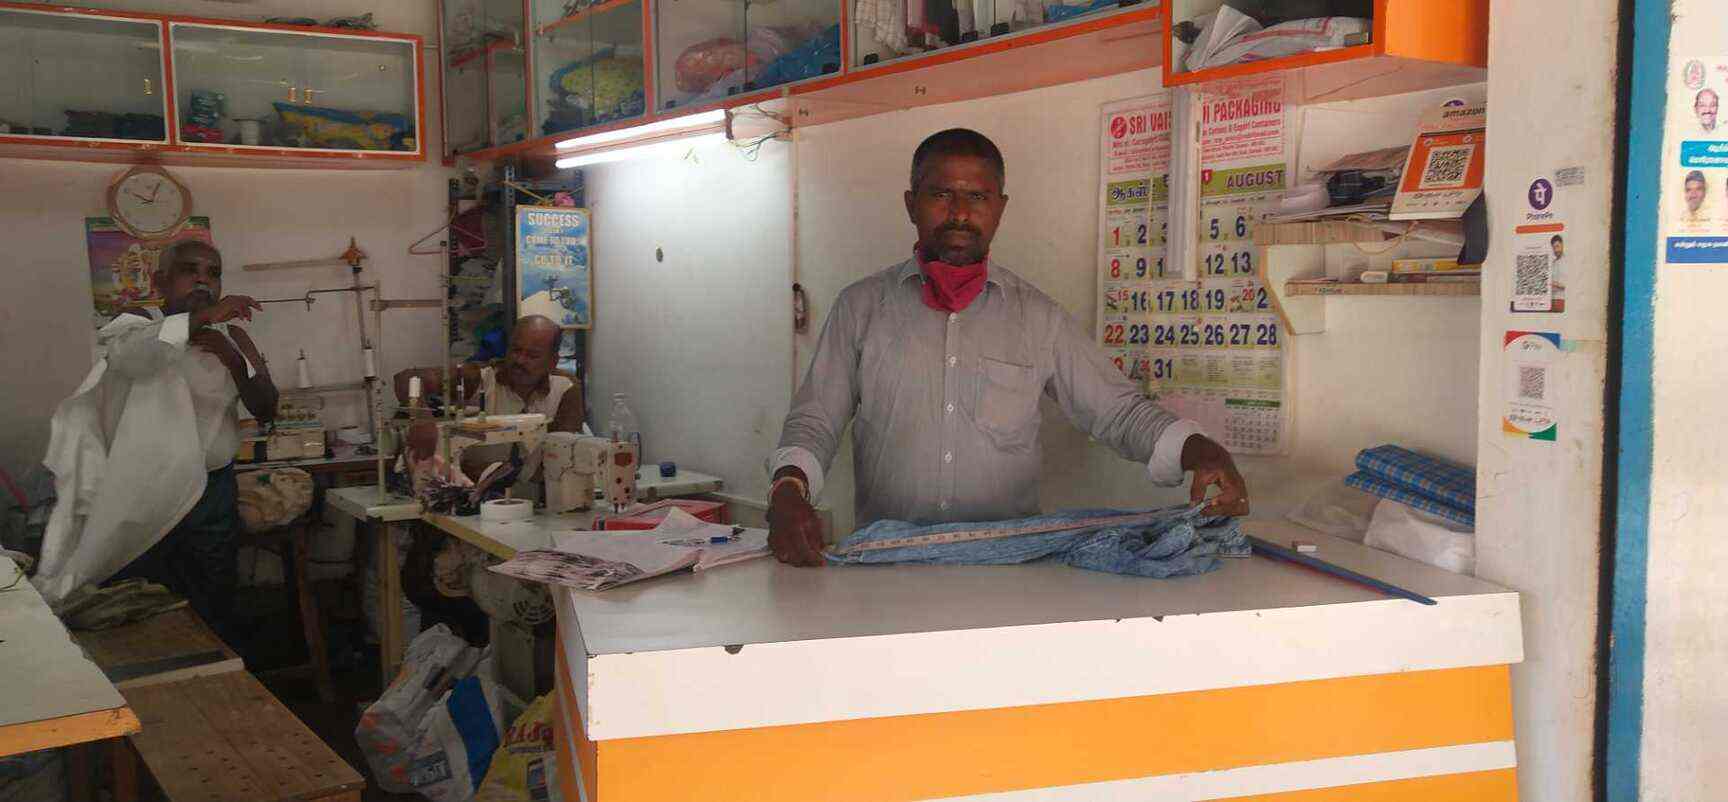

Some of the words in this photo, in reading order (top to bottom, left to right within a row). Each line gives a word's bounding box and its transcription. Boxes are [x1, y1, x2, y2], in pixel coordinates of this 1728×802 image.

[1442, 107, 1486, 119] amazon
[1130, 115, 1147, 135] SRI
[1227, 169, 1284, 189] AUGUST
[528, 212, 580, 227] SUCCESS
[1112, 227, 1120, 246] 1
[1137, 224, 1147, 245] 2
[1210, 218, 1220, 240] 5
[1235, 215, 1247, 238] 6
[1111, 258, 1121, 278] 8
[1136, 257, 1147, 277] 9
[1205, 253, 1225, 275] 12
[1231, 251, 1252, 274] 13
[1157, 291, 1175, 312] 17
[1182, 289, 1199, 311] 18
[1205, 288, 1225, 310] 19
[1256, 287, 1268, 309] 2
[1104, 324, 1125, 345] 22
[1129, 324, 1150, 345] 23
[1154, 324, 1175, 346] 24
[1180, 324, 1200, 346] 25
[1204, 323, 1225, 346] 26
[1230, 323, 1251, 345] 27
[1256, 323, 1277, 345] 28
[1154, 358, 1173, 379] 31
